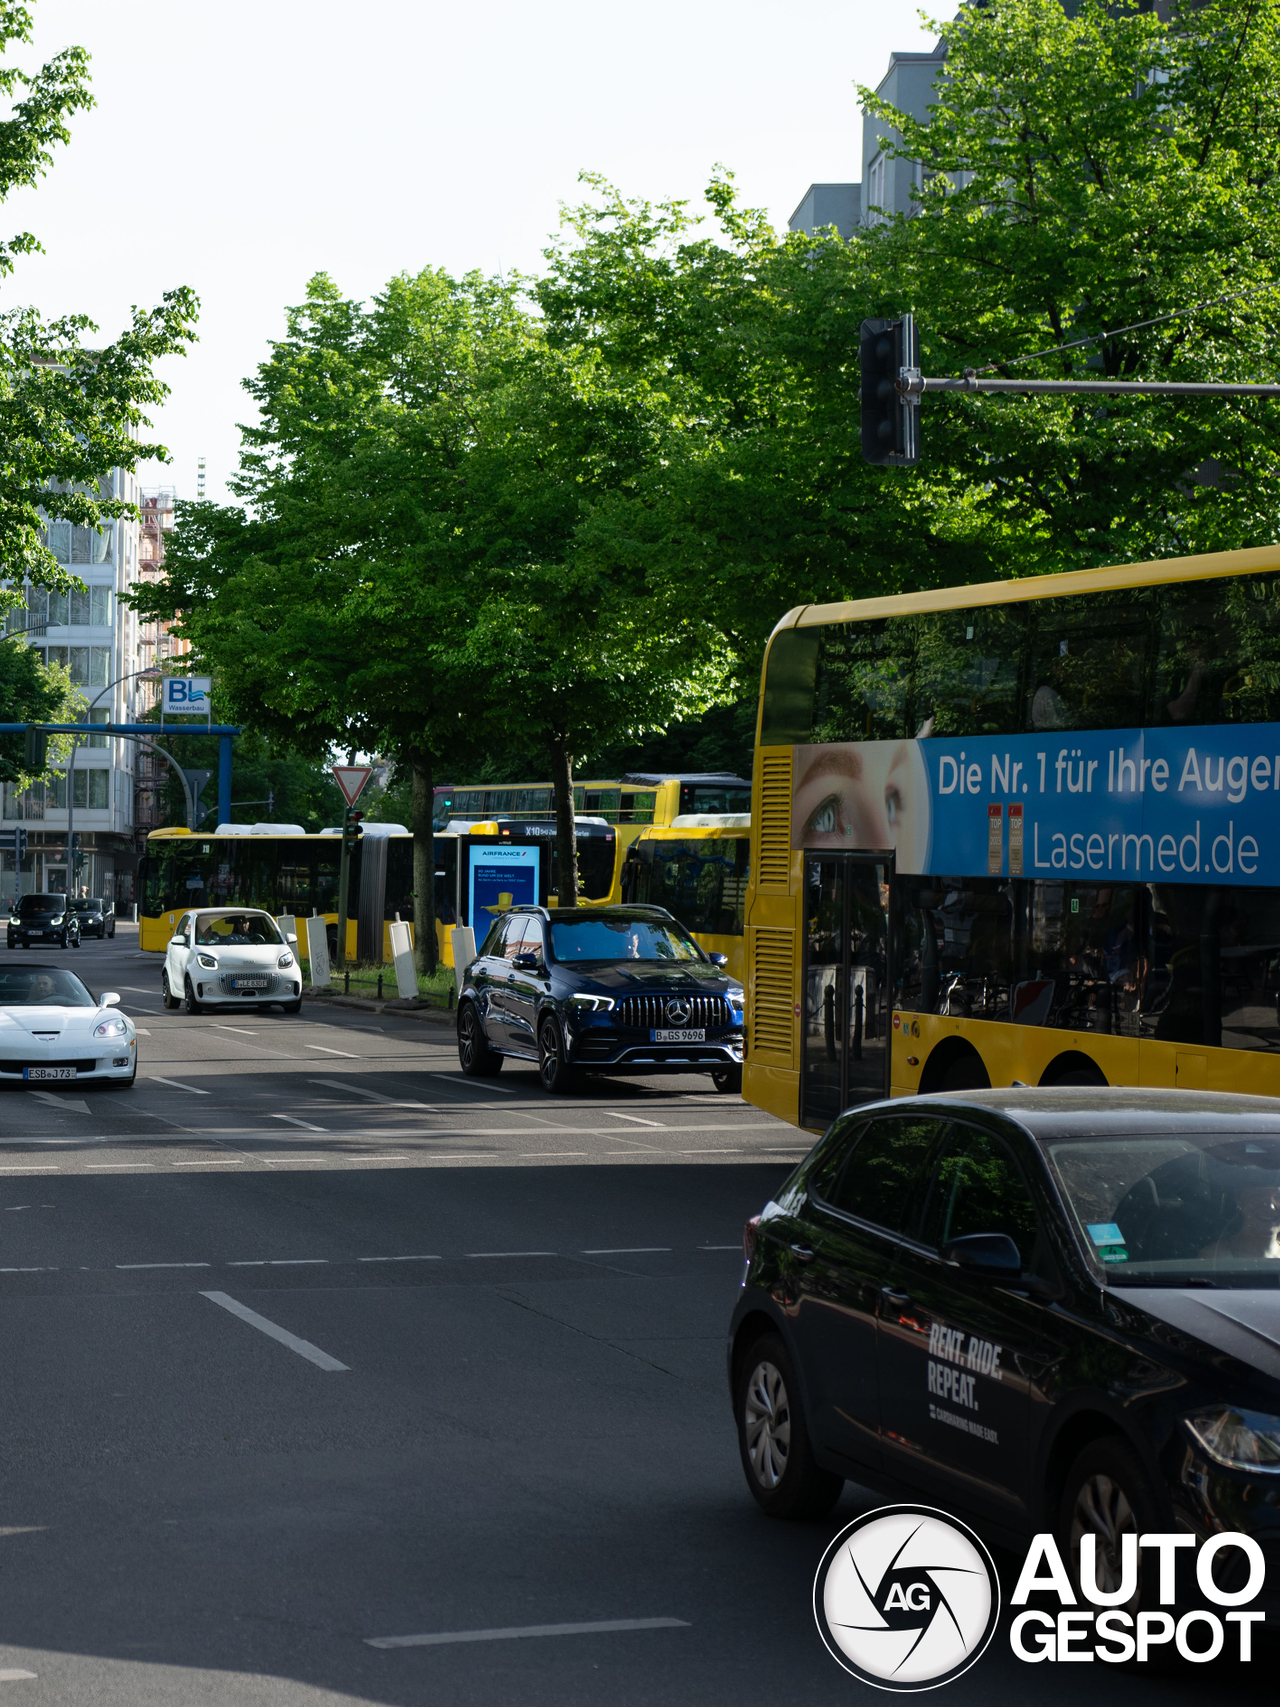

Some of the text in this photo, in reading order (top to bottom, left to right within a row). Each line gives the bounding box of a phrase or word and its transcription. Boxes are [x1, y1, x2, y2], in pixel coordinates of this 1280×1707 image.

[938, 752, 982, 795] Die
[990, 753, 1028, 794] Nr.
[1037, 752, 1046, 793] 1
[1055, 749, 1098, 793] für
[1108, 746, 1170, 793] Ihre
[990, 818, 1001, 829] TOP
[1011, 818, 1022, 829] TOP
[526, 827, 540, 836] X10
[990, 836, 1001, 846] 2023
[1010, 836, 1022, 846] 2023
[1034, 820, 1259, 874] Lasermed.de
[656, 1030, 704, 1041] B GS 9696
[28, 1068, 47, 1079] ESB
[59, 1068, 71, 1079] 73
[928, 1322, 1003, 1381] RENT. RIDE.
[927, 1360, 979, 1411] REPEAT.
